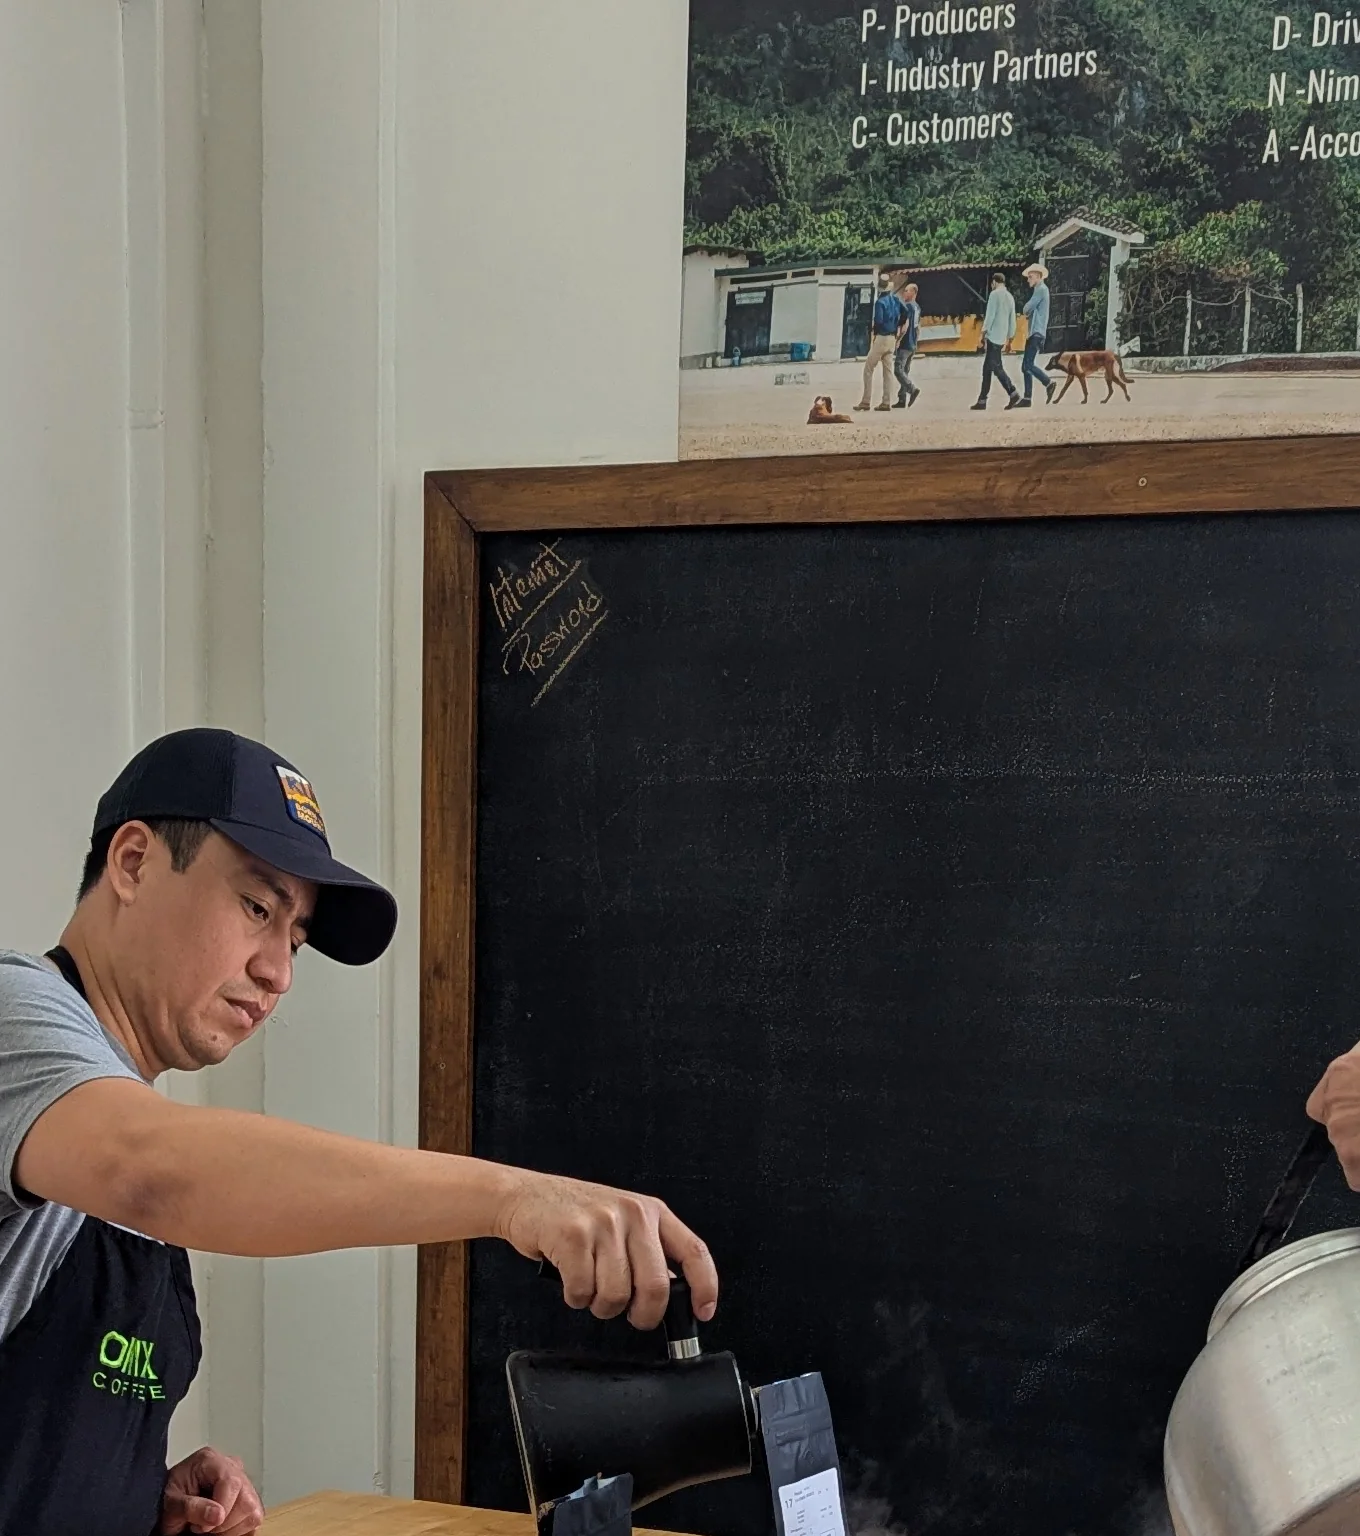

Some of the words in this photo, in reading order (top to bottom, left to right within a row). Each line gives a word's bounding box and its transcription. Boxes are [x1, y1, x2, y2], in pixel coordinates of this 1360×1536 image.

[895, 1, 1016, 38] Producers
[887, 57, 986, 93] Industry
[992, 48, 1097, 84] Partners
[886, 111, 1014, 146] Customers
[92, 1372, 166, 1401] COFFEE
